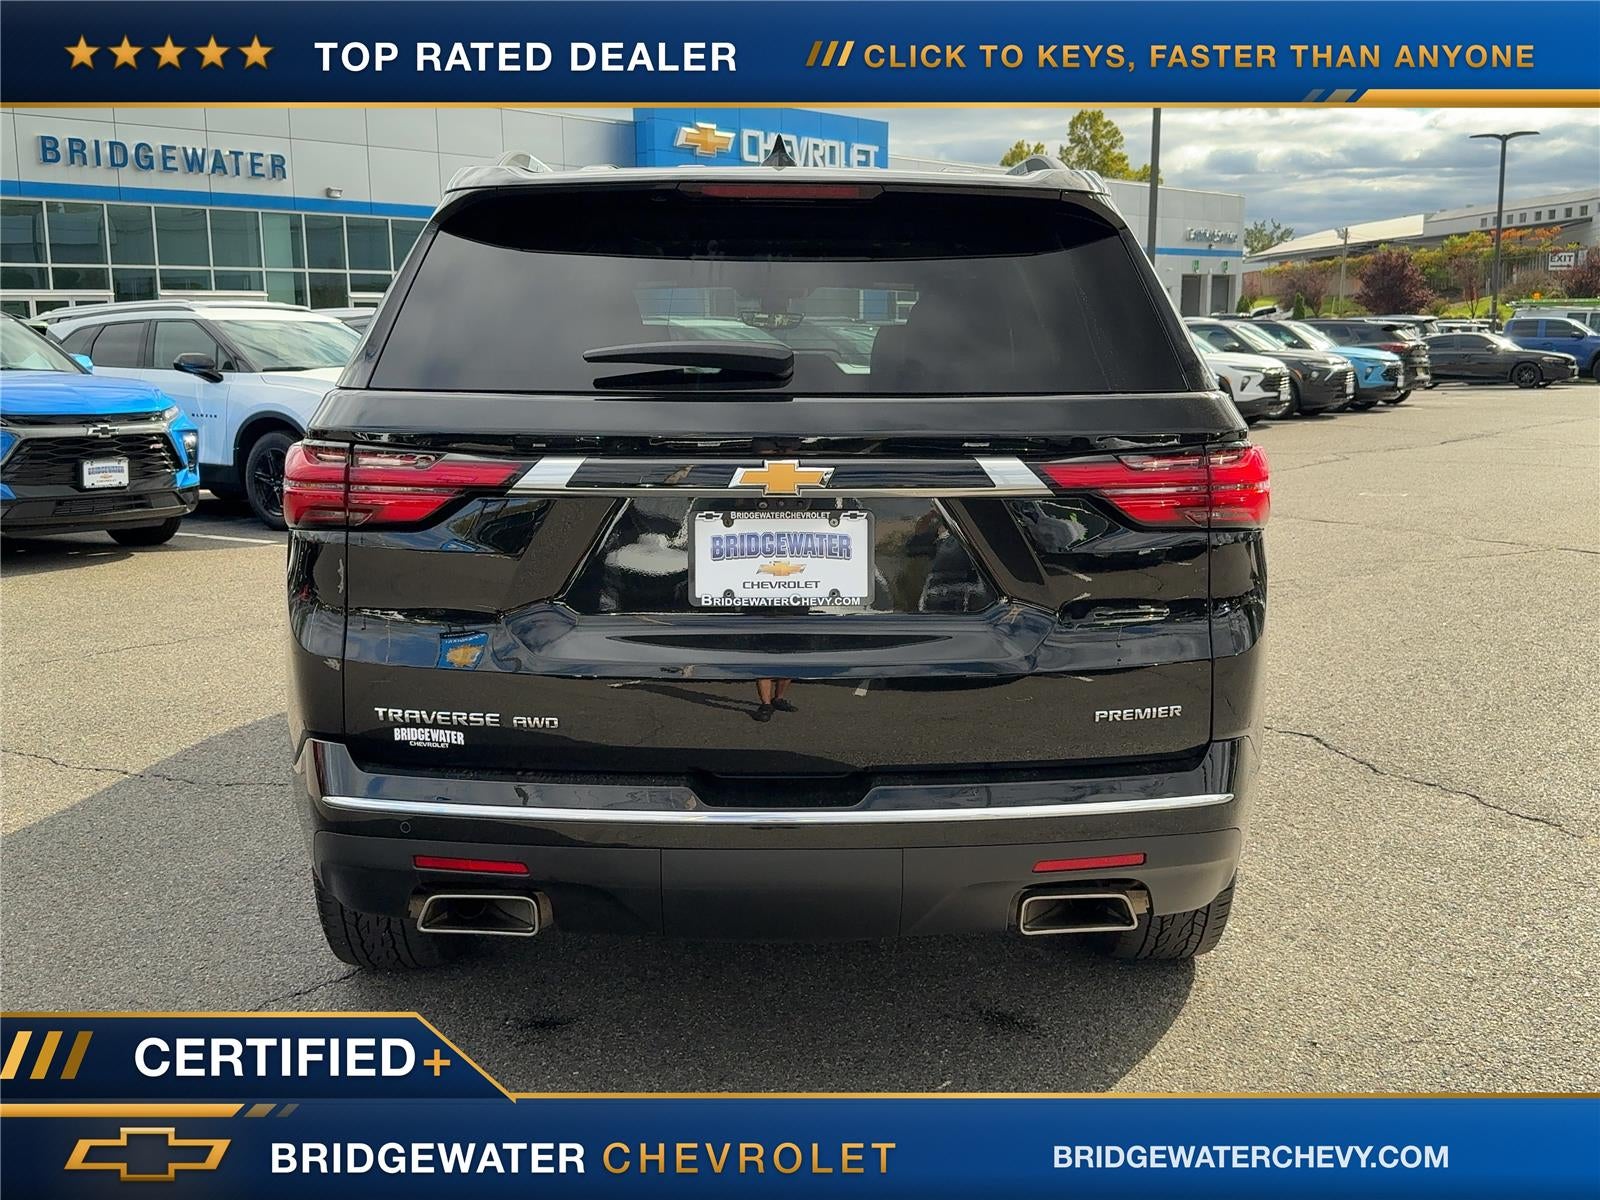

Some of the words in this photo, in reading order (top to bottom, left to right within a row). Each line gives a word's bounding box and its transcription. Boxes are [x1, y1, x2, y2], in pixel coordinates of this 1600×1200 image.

[39, 135, 288, 181] BRIDGEWATER
[1550, 254, 1574, 263] EXIT
[711, 531, 853, 561] BRIDGEWATER
[742, 580, 821, 590] CHEVROLET
[374, 707, 501, 727] TRAVERSE
[512, 716, 559, 729] AWD
[1095, 705, 1182, 722] PREMIER
[393, 727, 465, 746] BRIDGEWATER
[409, 740, 450, 749] CHEVROLET
